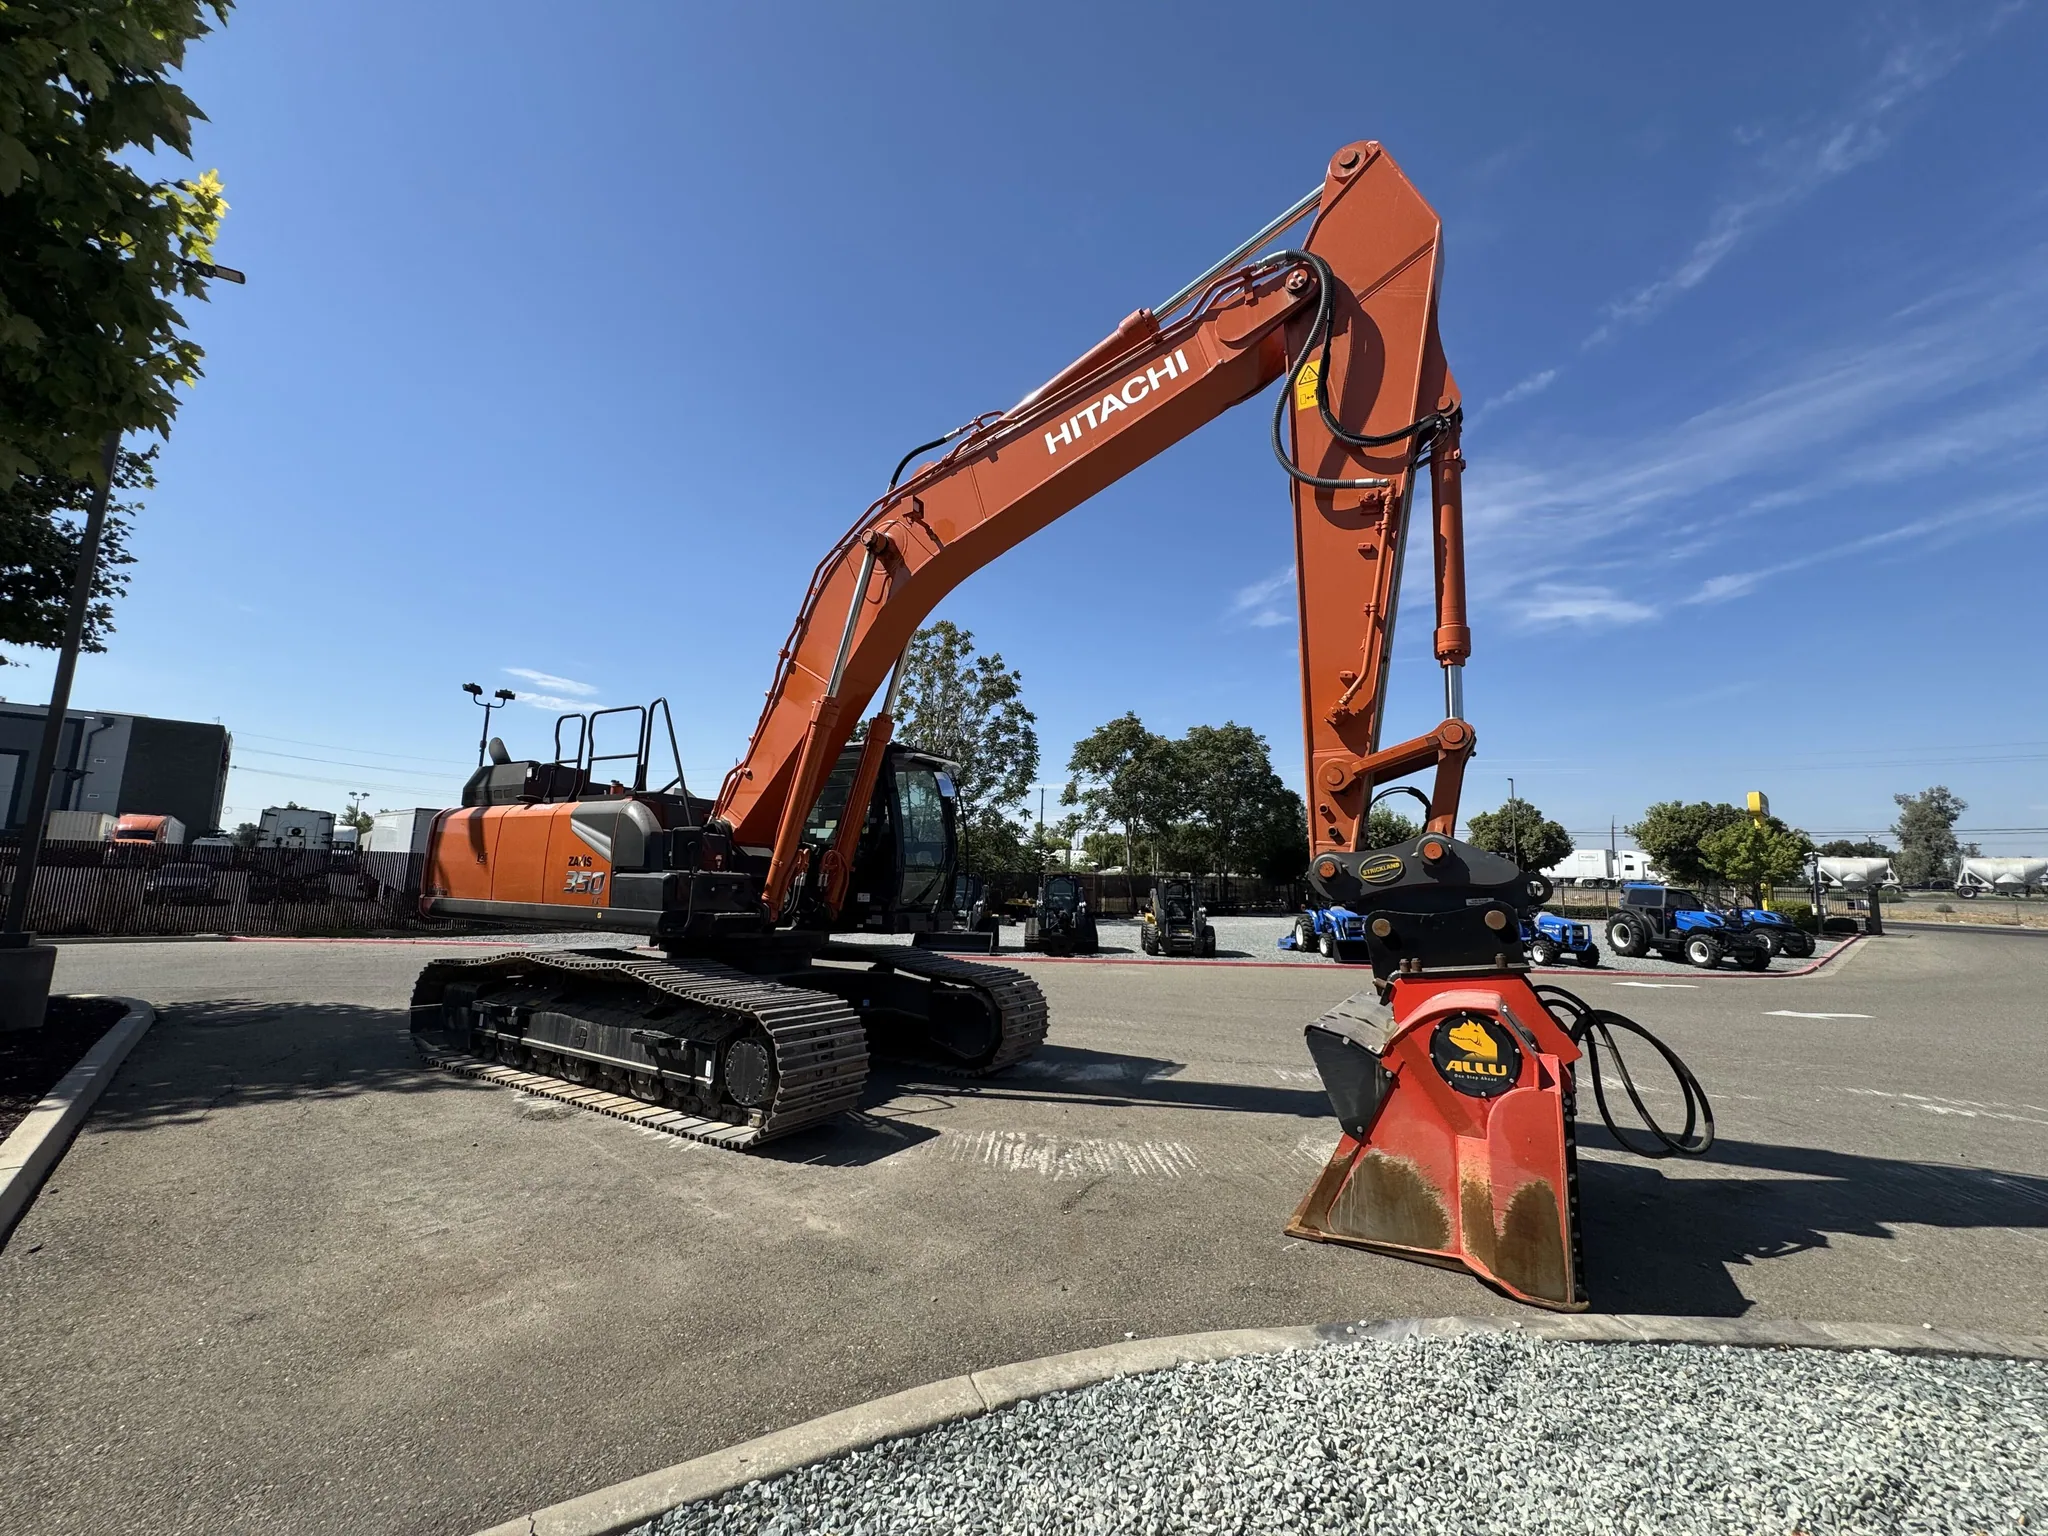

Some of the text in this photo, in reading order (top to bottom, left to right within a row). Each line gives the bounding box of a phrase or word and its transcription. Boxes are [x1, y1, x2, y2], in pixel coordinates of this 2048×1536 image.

[1044, 349, 1189, 454] HITACHI
[1362, 862, 1400, 876] STRICKLAND
[563, 870, 606, 894] 350
[1445, 1060, 1507, 1076] ALLU
